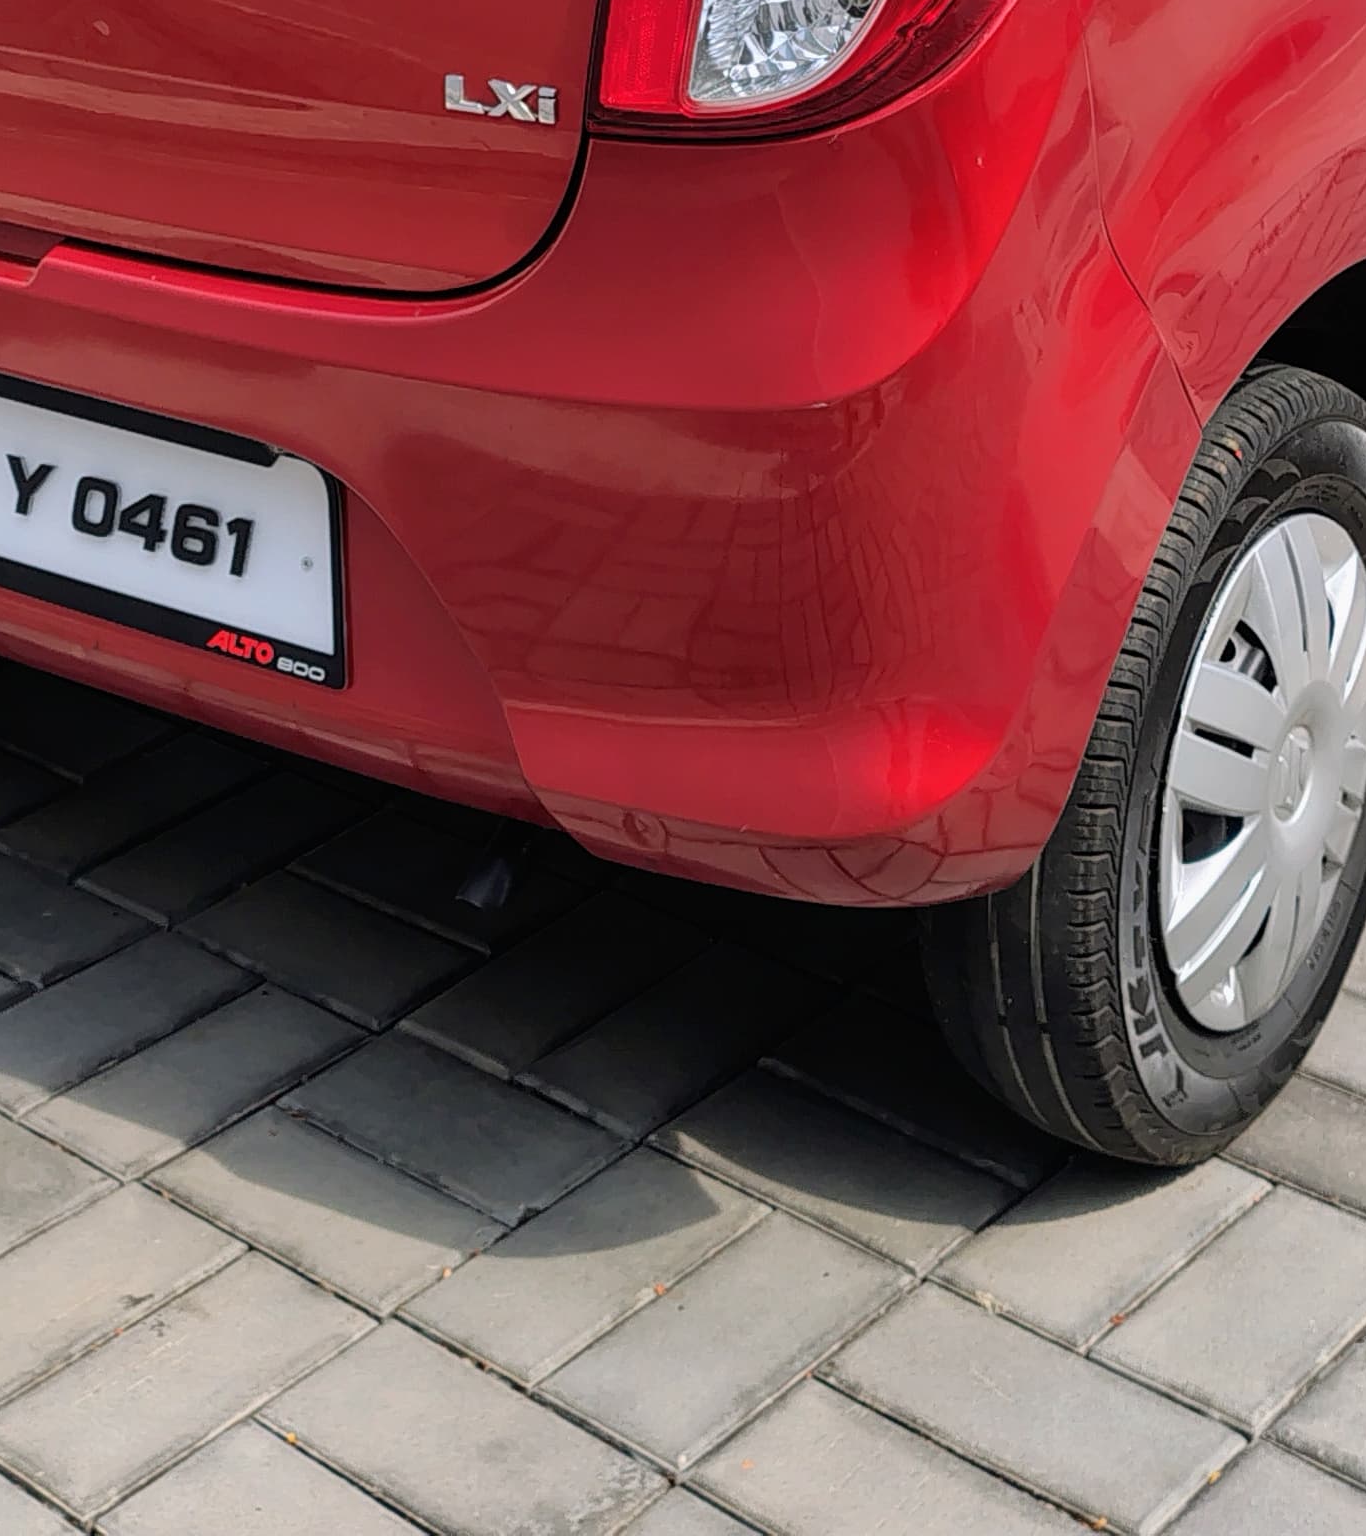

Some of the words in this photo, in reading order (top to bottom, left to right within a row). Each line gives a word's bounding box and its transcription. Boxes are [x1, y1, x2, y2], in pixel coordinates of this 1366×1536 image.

[444, 73, 558, 125] LXi
[7, 454, 56, 516] Y
[71, 476, 254, 576] 0461
[206, 630, 275, 664] ALTO
[276, 656, 326, 682] 800
